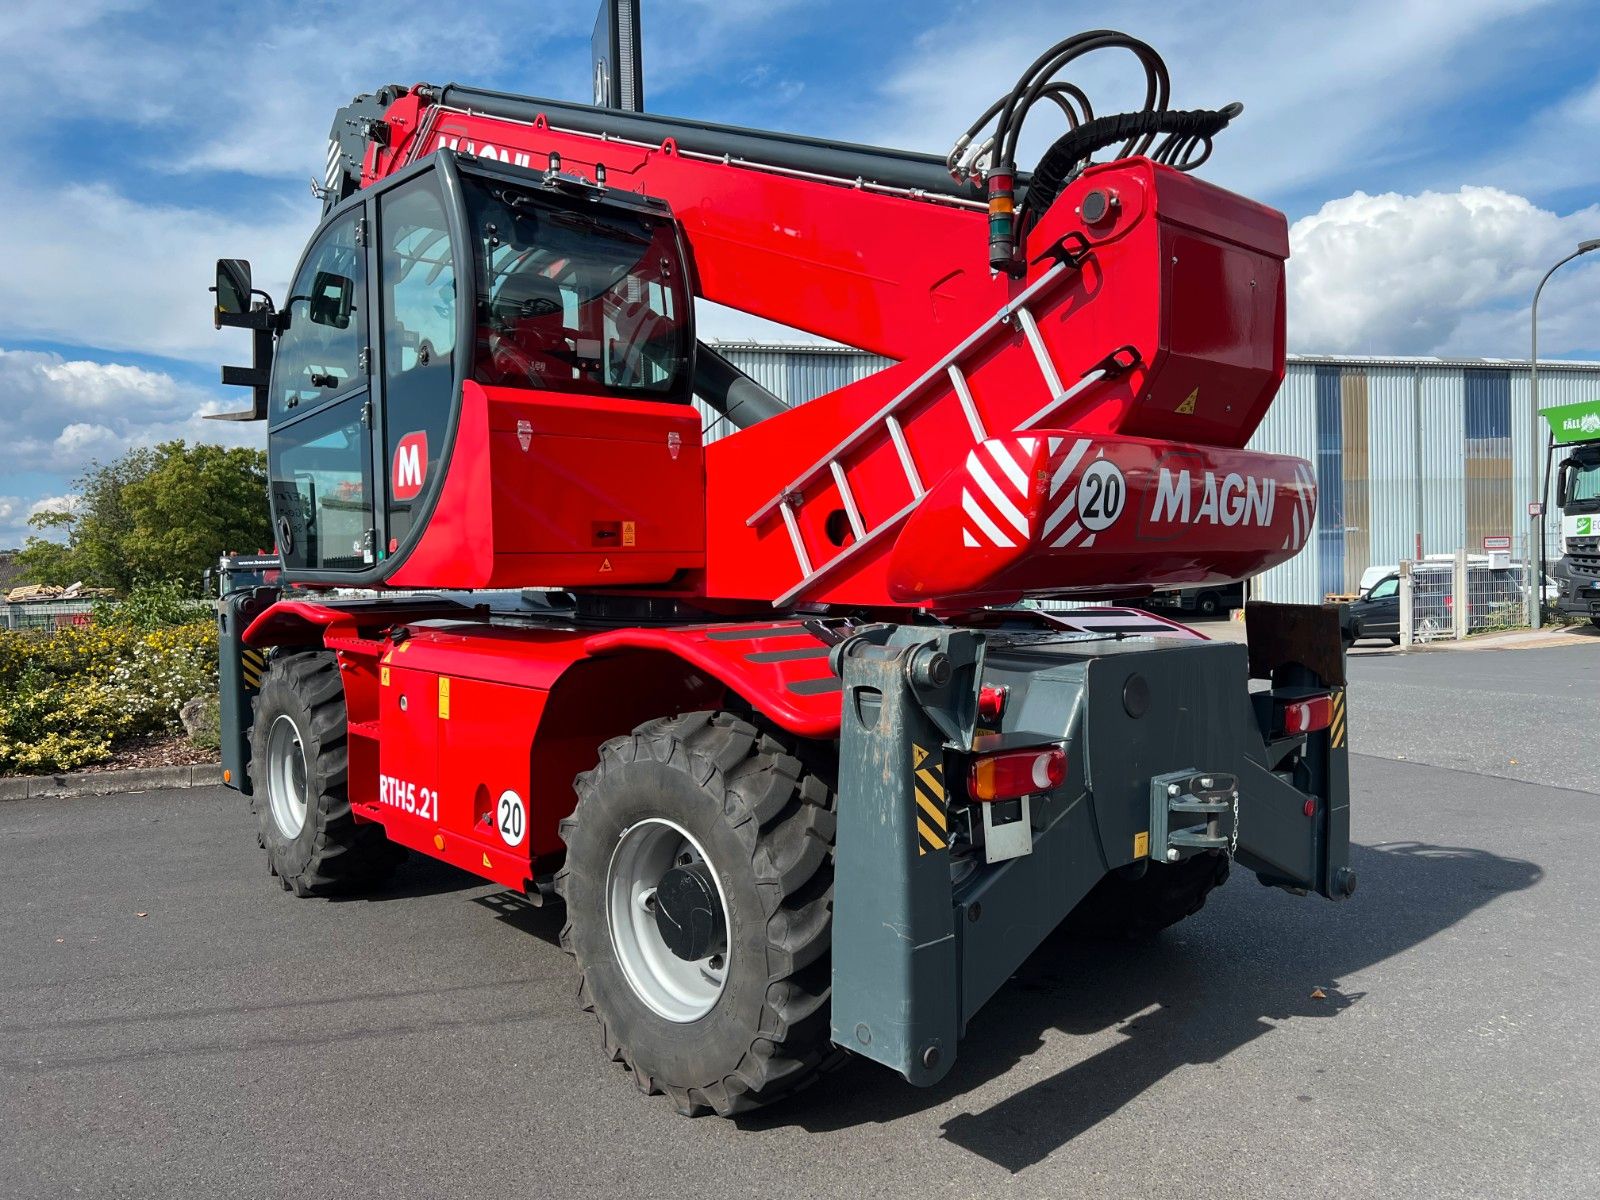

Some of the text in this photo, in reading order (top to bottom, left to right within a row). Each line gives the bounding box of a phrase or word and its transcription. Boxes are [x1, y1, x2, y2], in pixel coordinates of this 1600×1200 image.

[398, 444, 422, 487] M
[1082, 473, 1120, 519] 20
[1150, 468, 1276, 527] MAGNI
[380, 774, 438, 822] RTH5.21
[501, 799, 521, 838] 20
